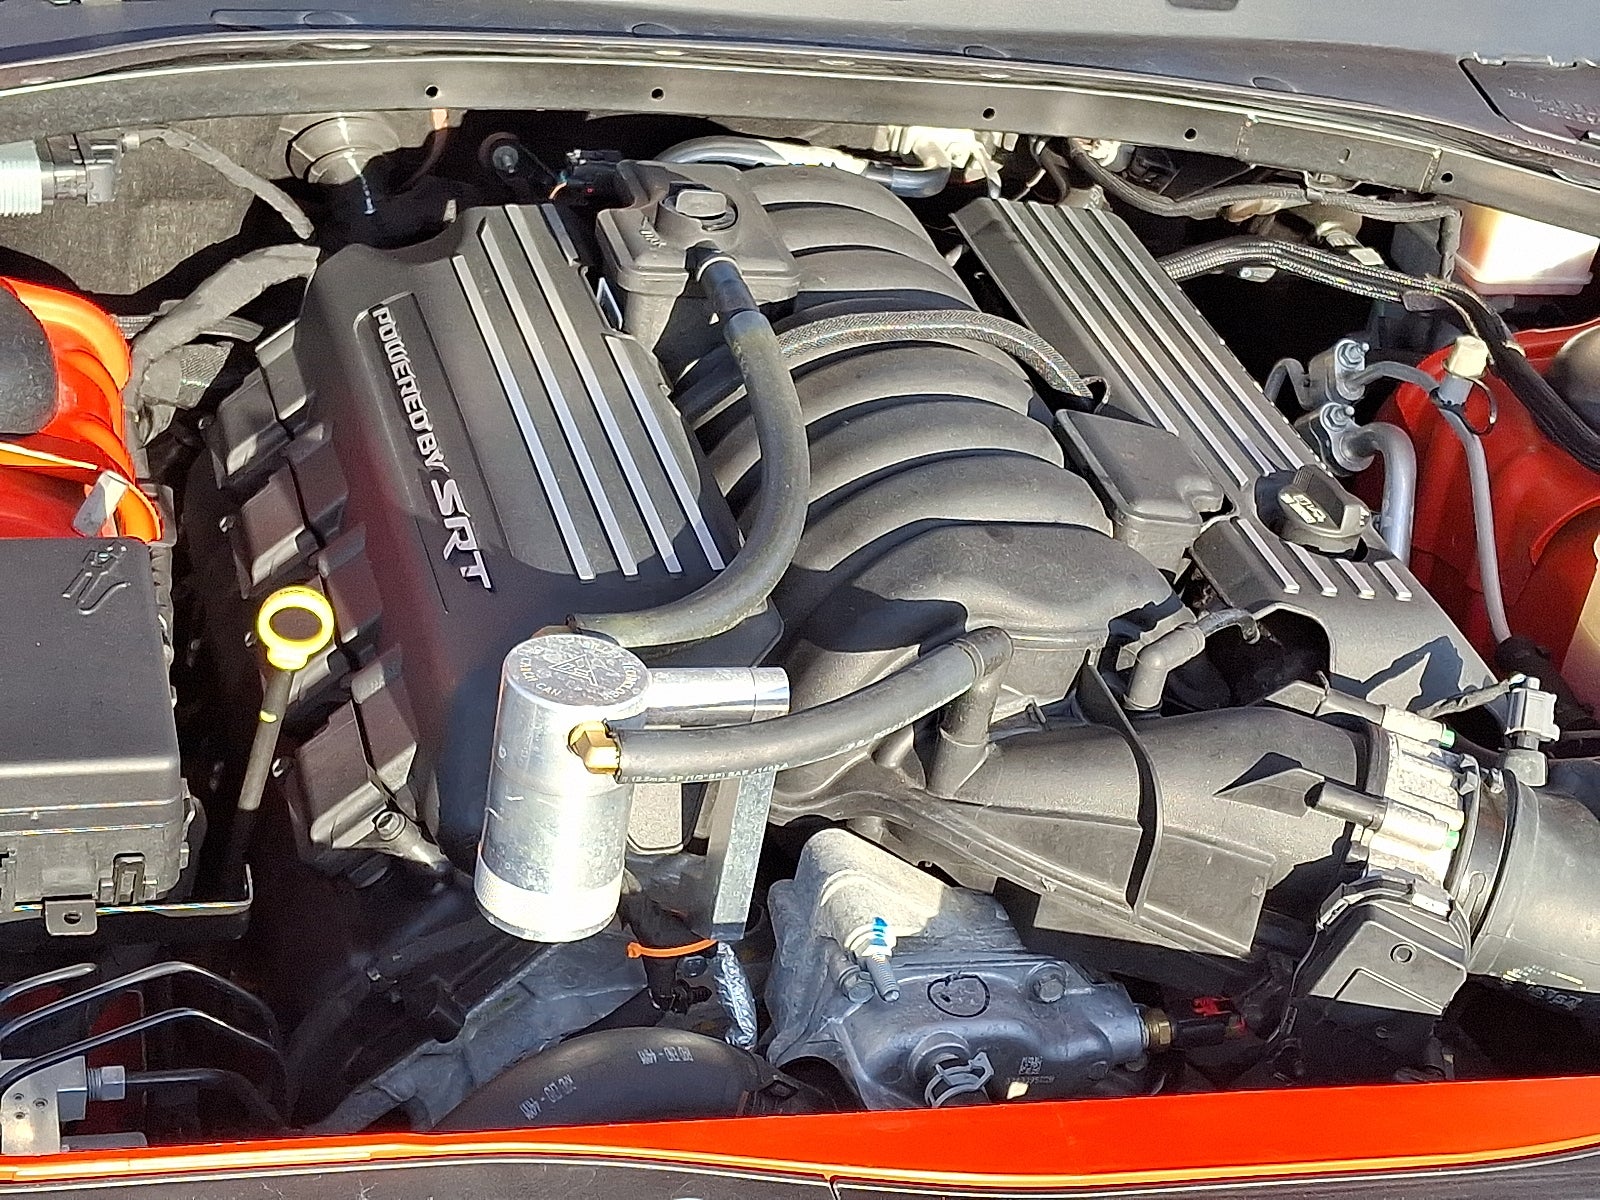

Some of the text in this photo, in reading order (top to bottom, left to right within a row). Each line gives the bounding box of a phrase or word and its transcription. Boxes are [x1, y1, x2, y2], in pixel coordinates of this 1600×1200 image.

[372, 305, 450, 473] POWERED BY
[431, 478, 492, 589] SRT
[535, 682, 562, 697] CAN
